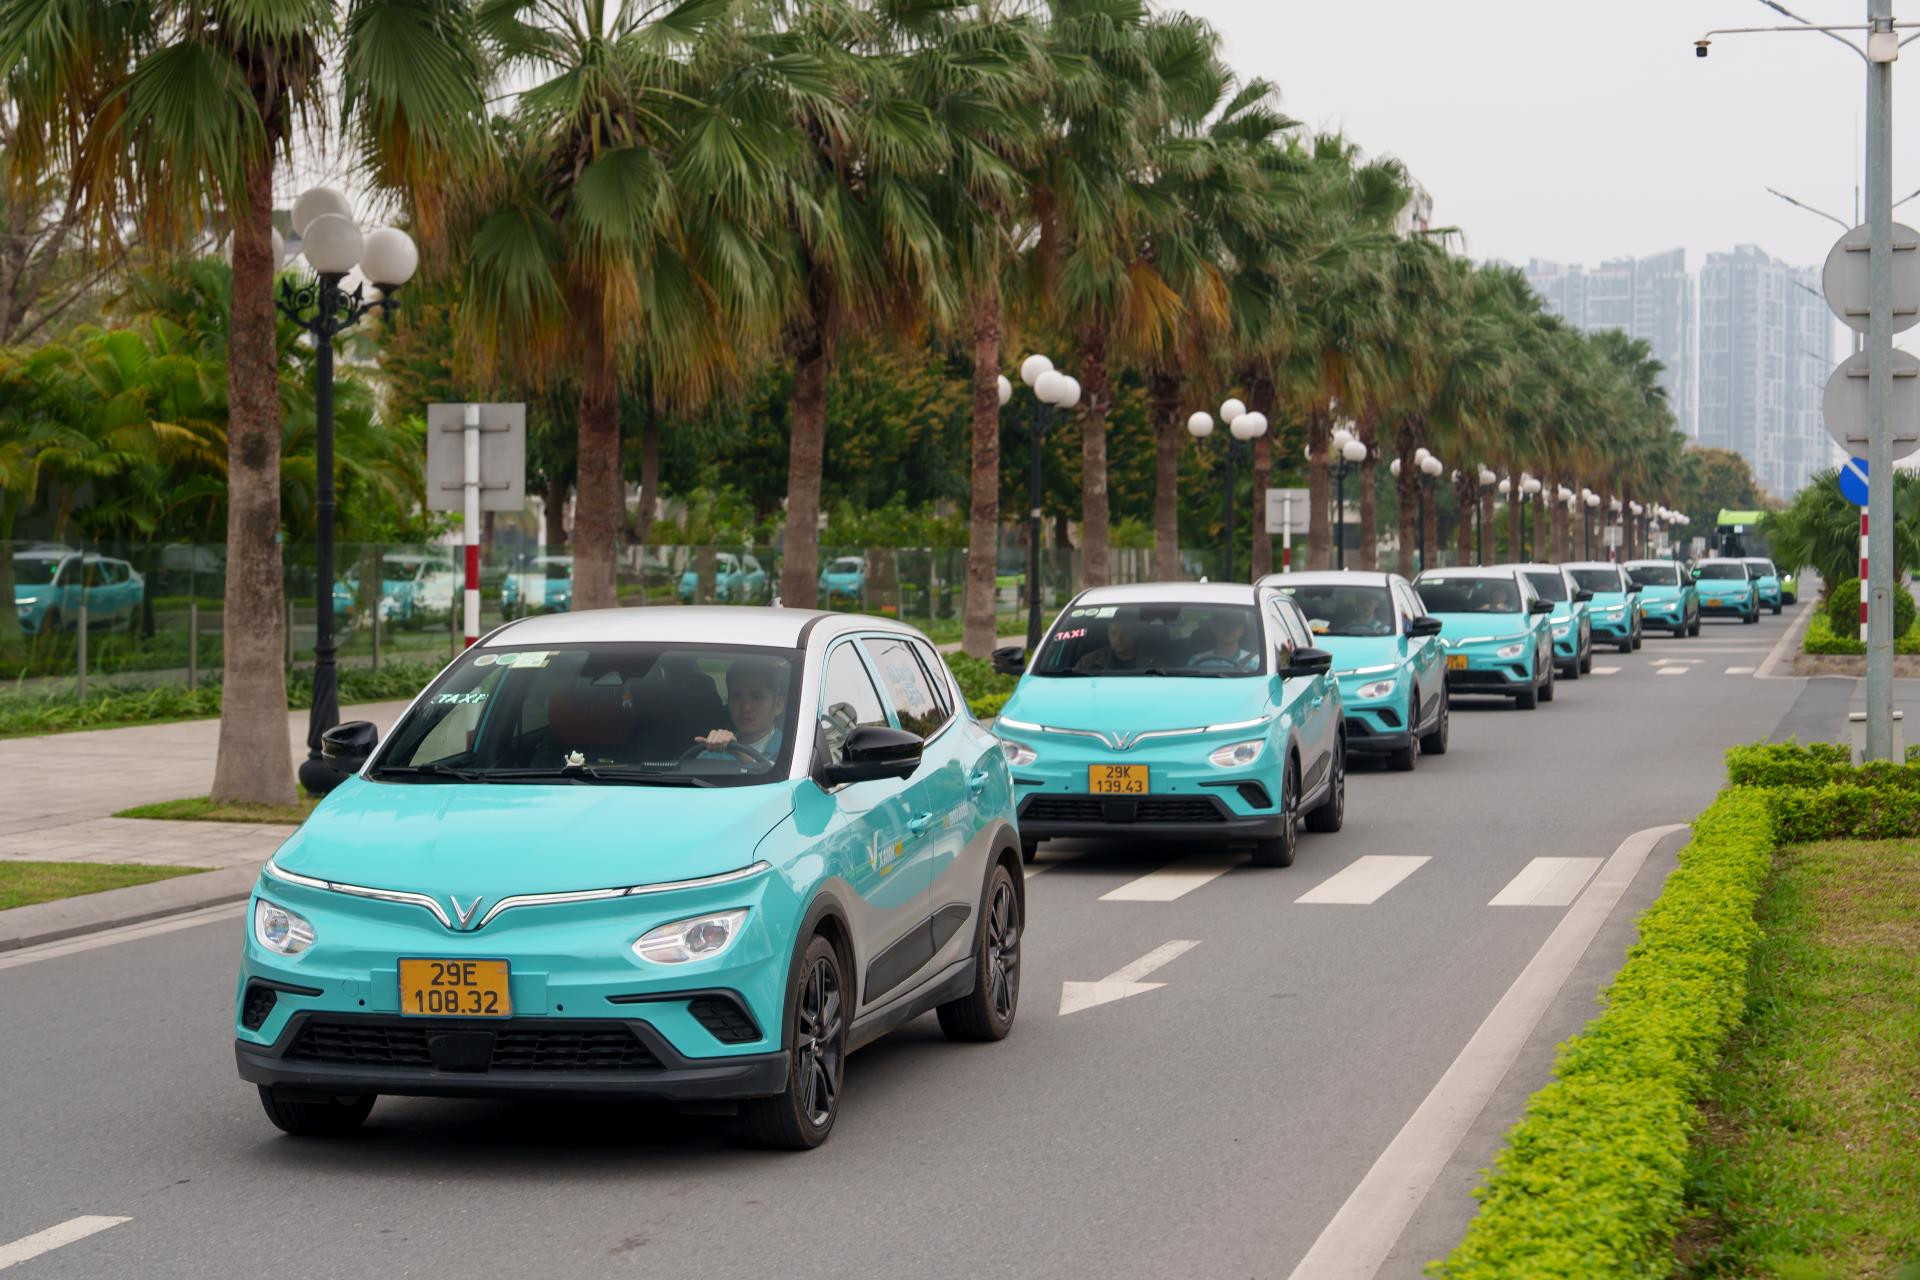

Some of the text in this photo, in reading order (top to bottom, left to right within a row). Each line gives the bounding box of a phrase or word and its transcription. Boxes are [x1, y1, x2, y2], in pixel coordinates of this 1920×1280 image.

[1056, 628, 1086, 640] TAXI
[438, 693, 489, 704] TAXI
[1106, 766, 1131, 778] 29K
[1097, 780, 1142, 792] 139.43
[430, 962, 477, 986] 29E
[415, 989, 498, 1014] 108.32
